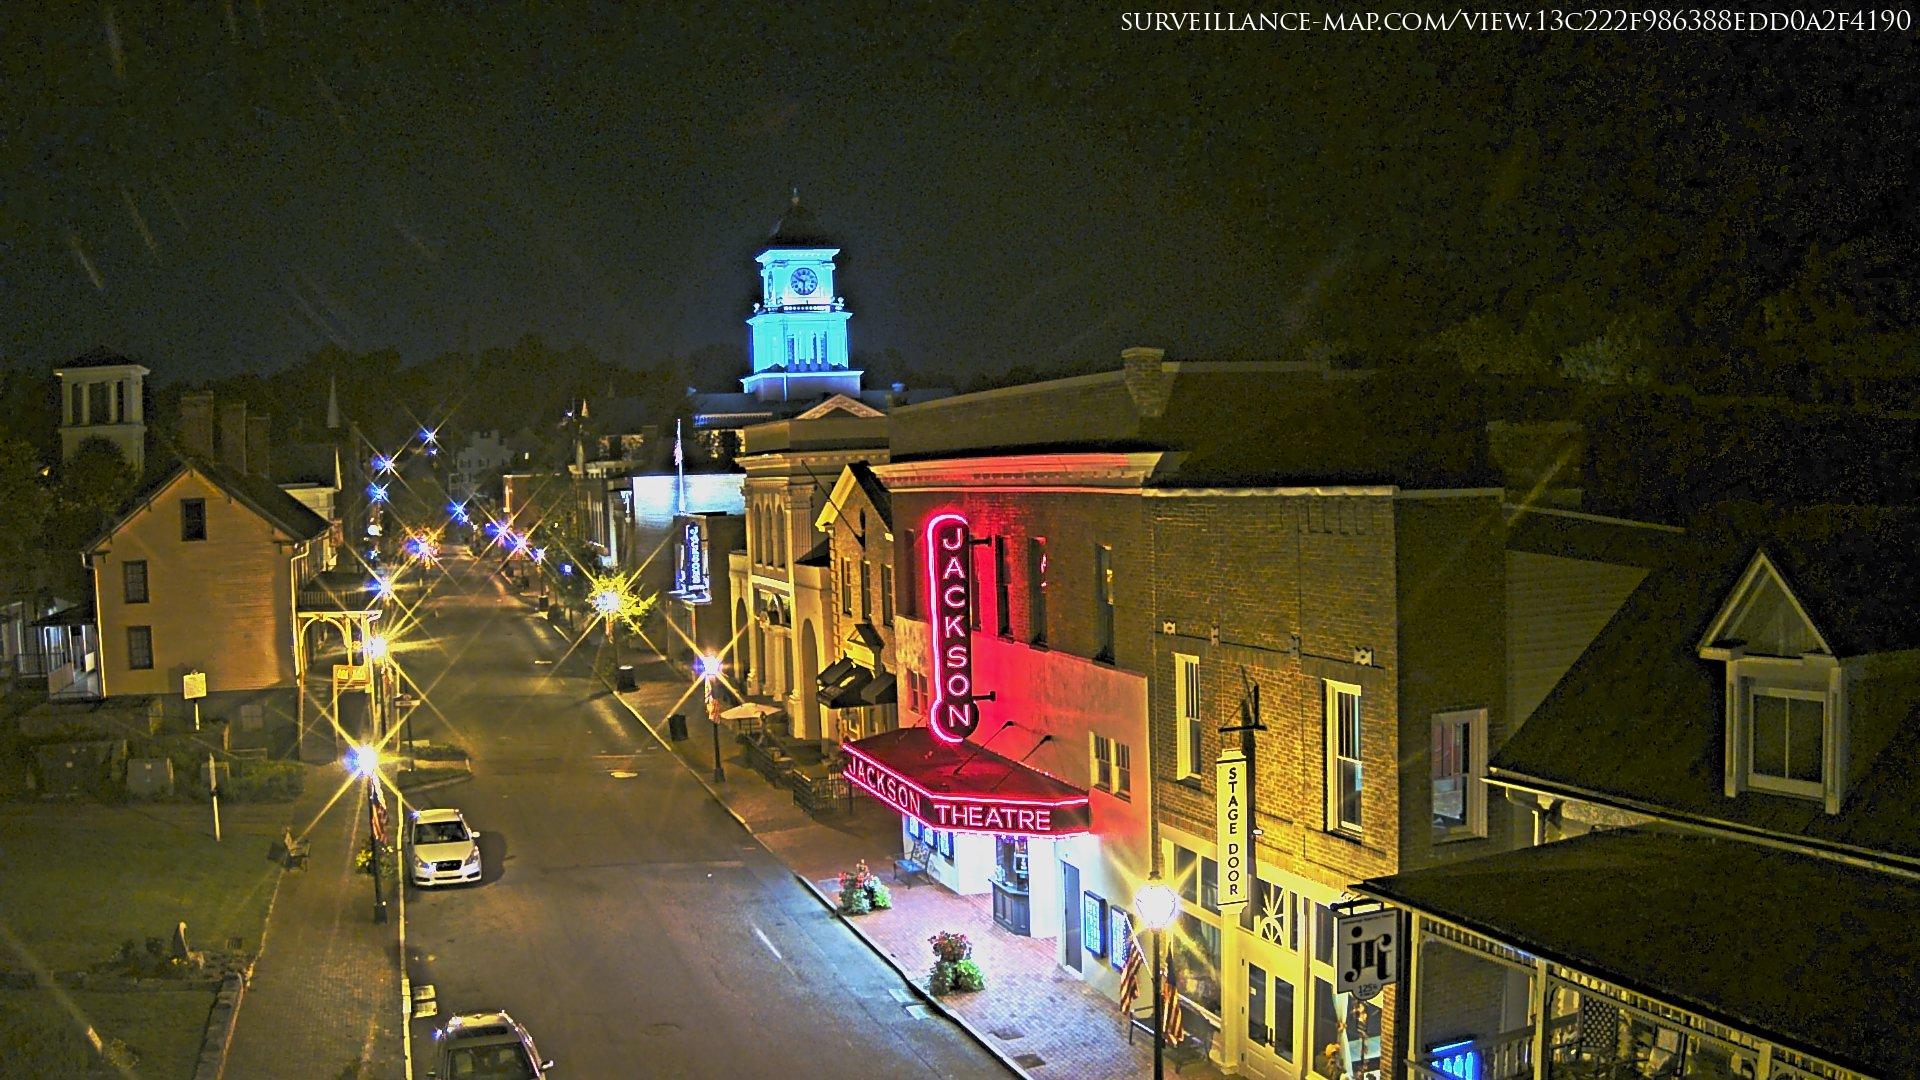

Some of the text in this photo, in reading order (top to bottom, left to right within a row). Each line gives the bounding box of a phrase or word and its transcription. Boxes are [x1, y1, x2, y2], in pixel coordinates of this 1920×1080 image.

[942, 527, 970, 728] JACKSON
[847, 756, 1051, 831] JACKSON THEATRE
[1227, 767, 1240, 895] STAGE DOOR
